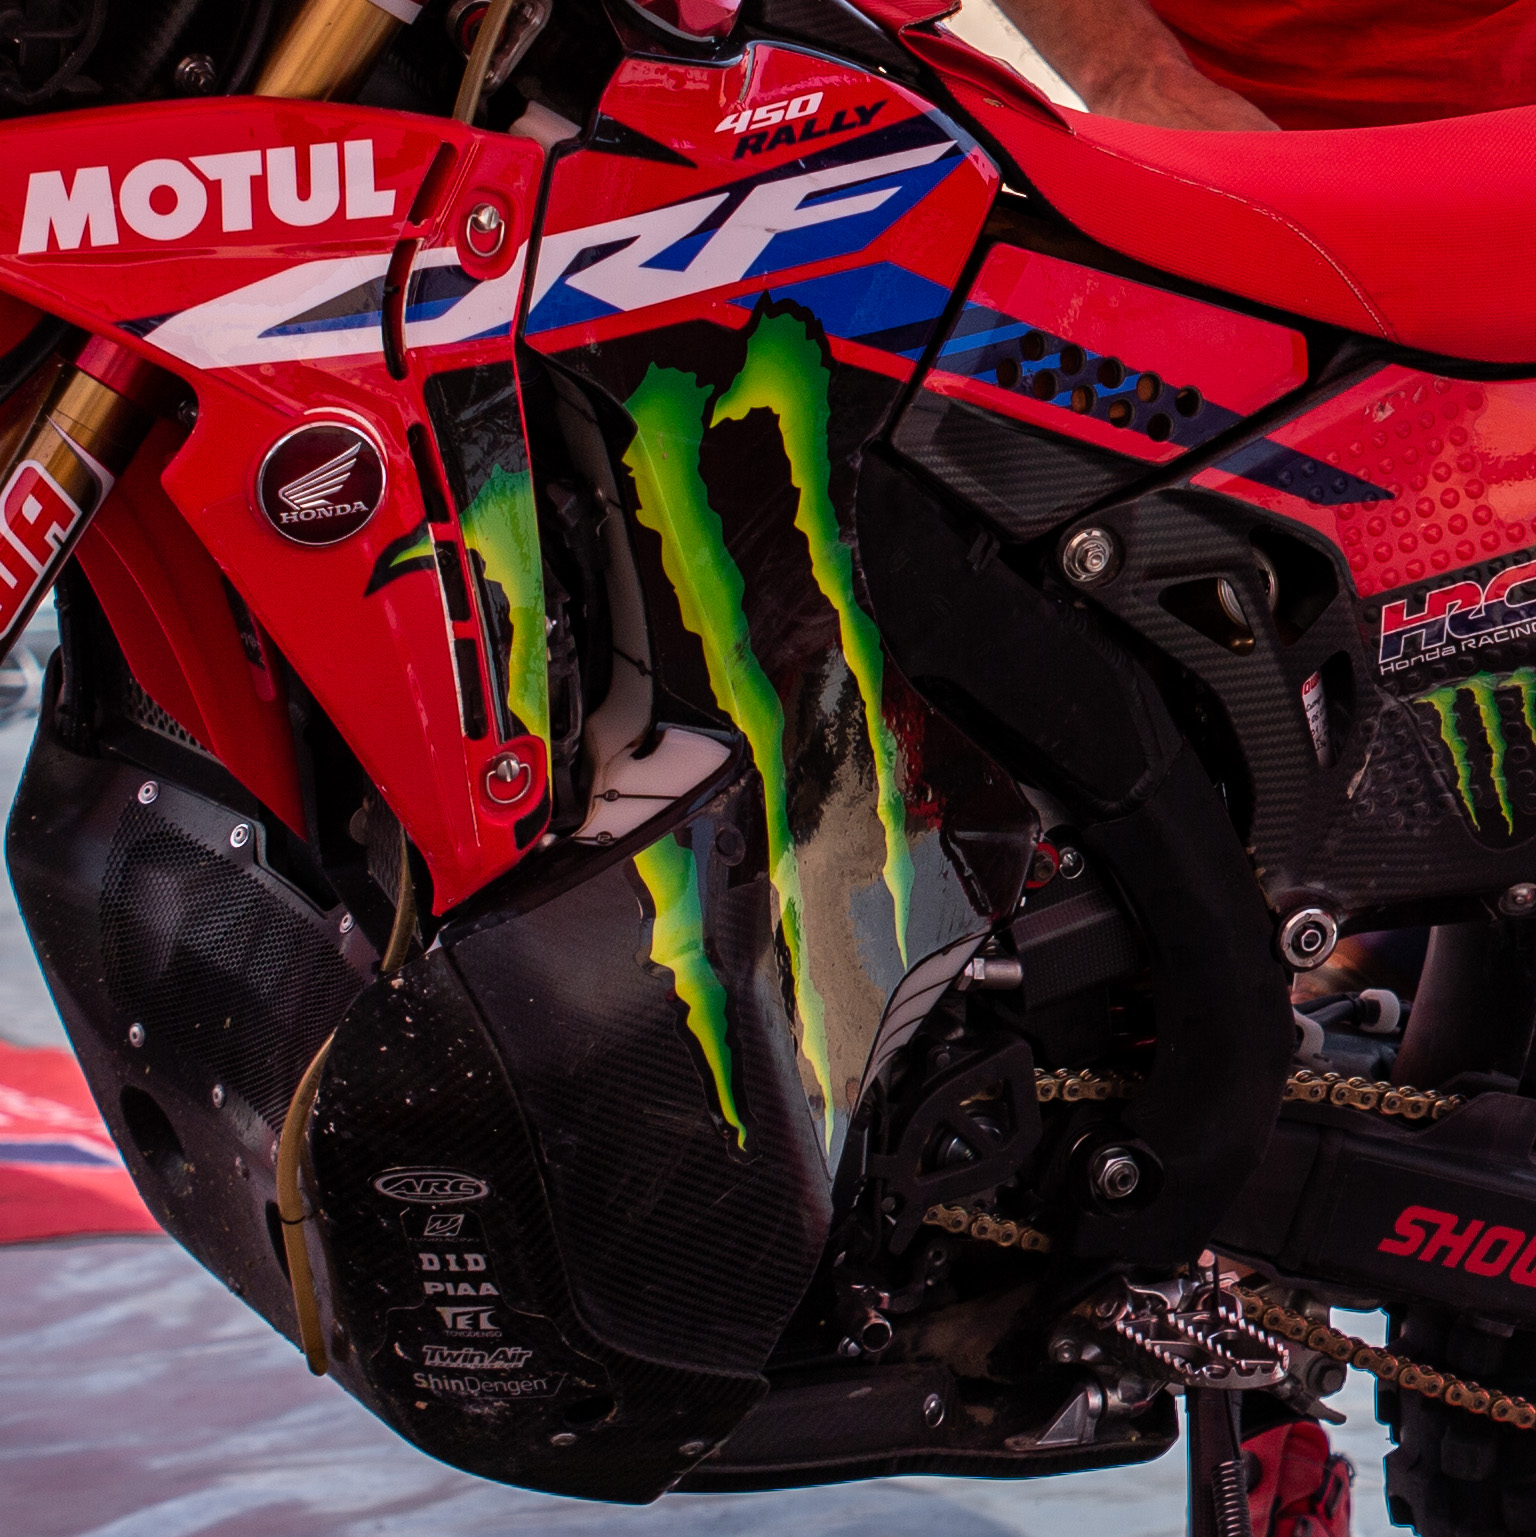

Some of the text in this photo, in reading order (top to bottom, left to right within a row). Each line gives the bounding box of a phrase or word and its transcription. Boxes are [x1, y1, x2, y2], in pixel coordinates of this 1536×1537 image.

[714, 91, 824, 135] 450
[732, 99, 889, 161] RALLY
[18, 139, 397, 255] MOTUL
[279, 499, 370, 526] HONDA
[1381, 645, 1457, 676] Honda
[387, 1177, 484, 1197] ARC
[423, 1281, 500, 1296] PIAA
[422, 1345, 533, 1368] Twin Air
[412, 1371, 548, 1395] ShinDengen
